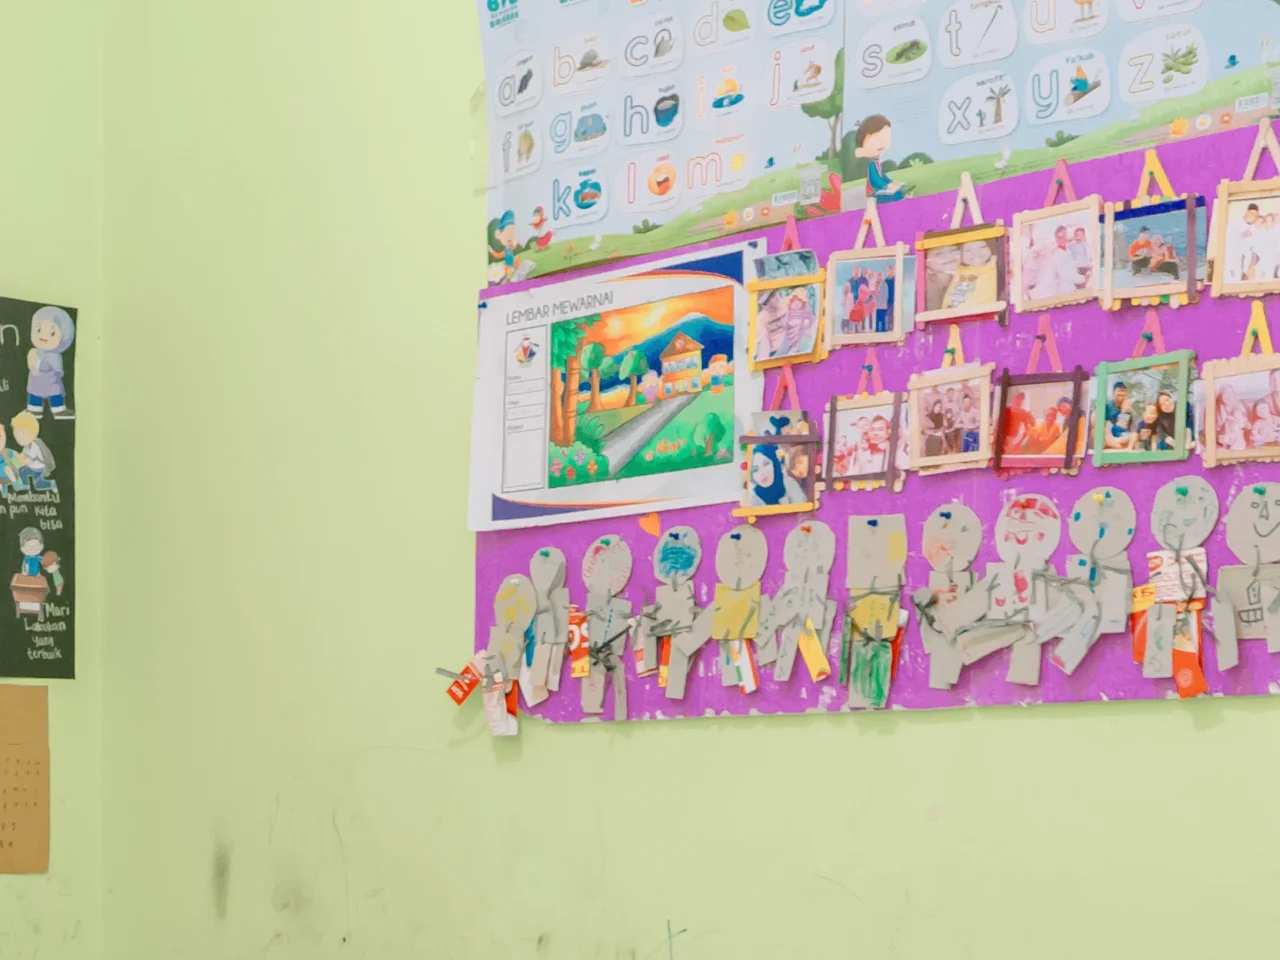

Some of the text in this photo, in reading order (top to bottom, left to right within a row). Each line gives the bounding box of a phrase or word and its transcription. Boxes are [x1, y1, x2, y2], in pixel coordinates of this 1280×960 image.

[553, 46, 576, 87] b
[624, 35, 649, 67] c
[861, 43, 884, 78] s
[498, 74, 516, 107] a
[1032, 69, 1059, 119] y
[1128, 53, 1155, 94] z
[550, 110, 572, 154] g
[624, 95, 650, 137] h
[687, 151, 723, 189] m
[552, 178, 572, 221] k
[506, 290, 614, 326] LEMBAR MEWARNAI
